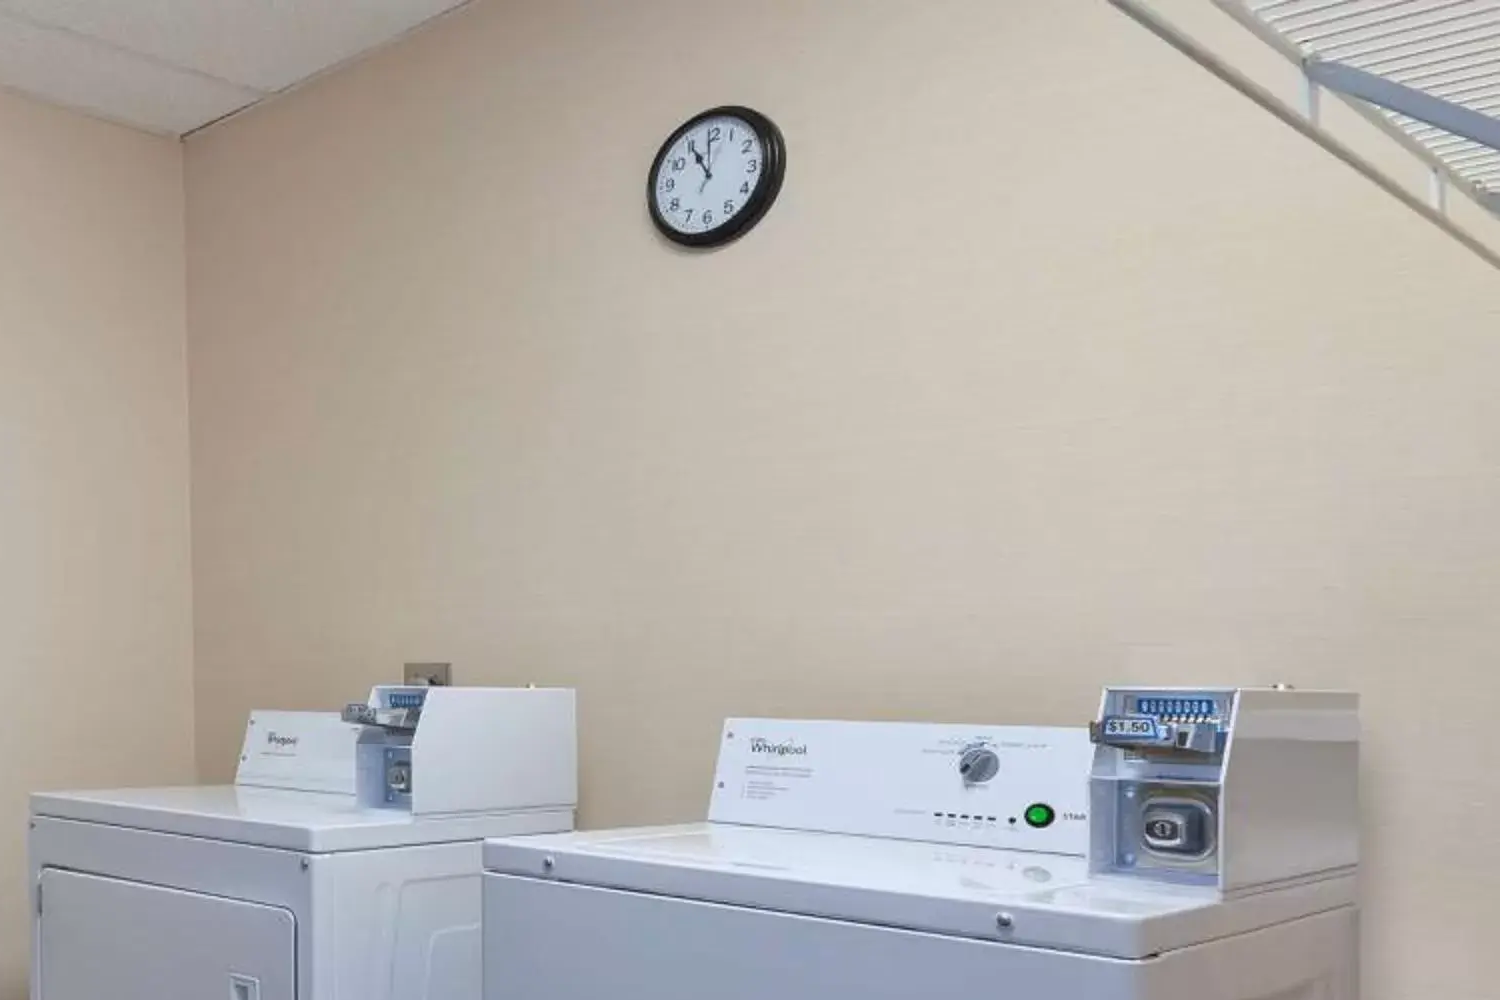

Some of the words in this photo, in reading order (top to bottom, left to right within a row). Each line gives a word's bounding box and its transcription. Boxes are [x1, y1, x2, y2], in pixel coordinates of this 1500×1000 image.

[741, 139, 753, 154] 2
[671, 156, 686, 172] 10
[746, 159, 757, 174] 3
[665, 178, 675, 192] 9
[740, 181, 750, 195] 4
[670, 198, 680, 212] 8
[724, 200, 734, 215] 5
[684, 209, 694, 223] 7
[702, 210, 713, 225] 6
[750, 743, 808, 757] Whirlpool
